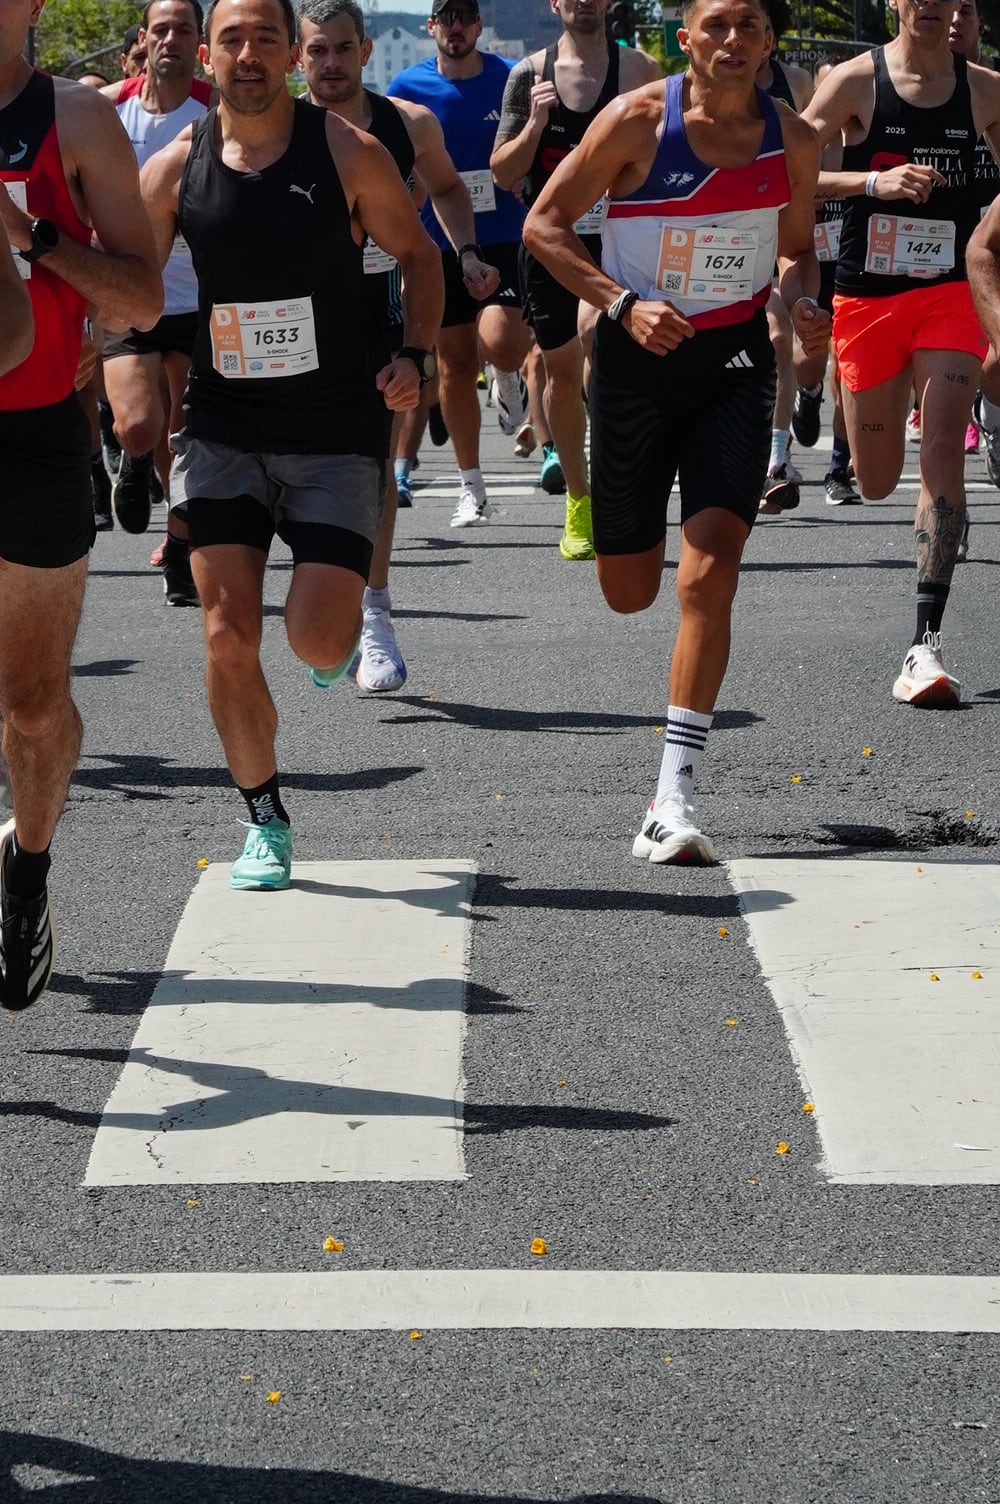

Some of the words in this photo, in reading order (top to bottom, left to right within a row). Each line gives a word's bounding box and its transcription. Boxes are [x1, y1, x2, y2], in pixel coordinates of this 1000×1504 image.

[885, 126, 906, 135] 2025
[930, 147, 960, 156] balance
[877, 219, 892, 235] D
[670, 229, 688, 247] D
[906, 241, 942, 256] 1474
[704, 255, 745, 270] 1674
[214, 309, 232, 327] D
[254, 326, 300, 346] 1633
